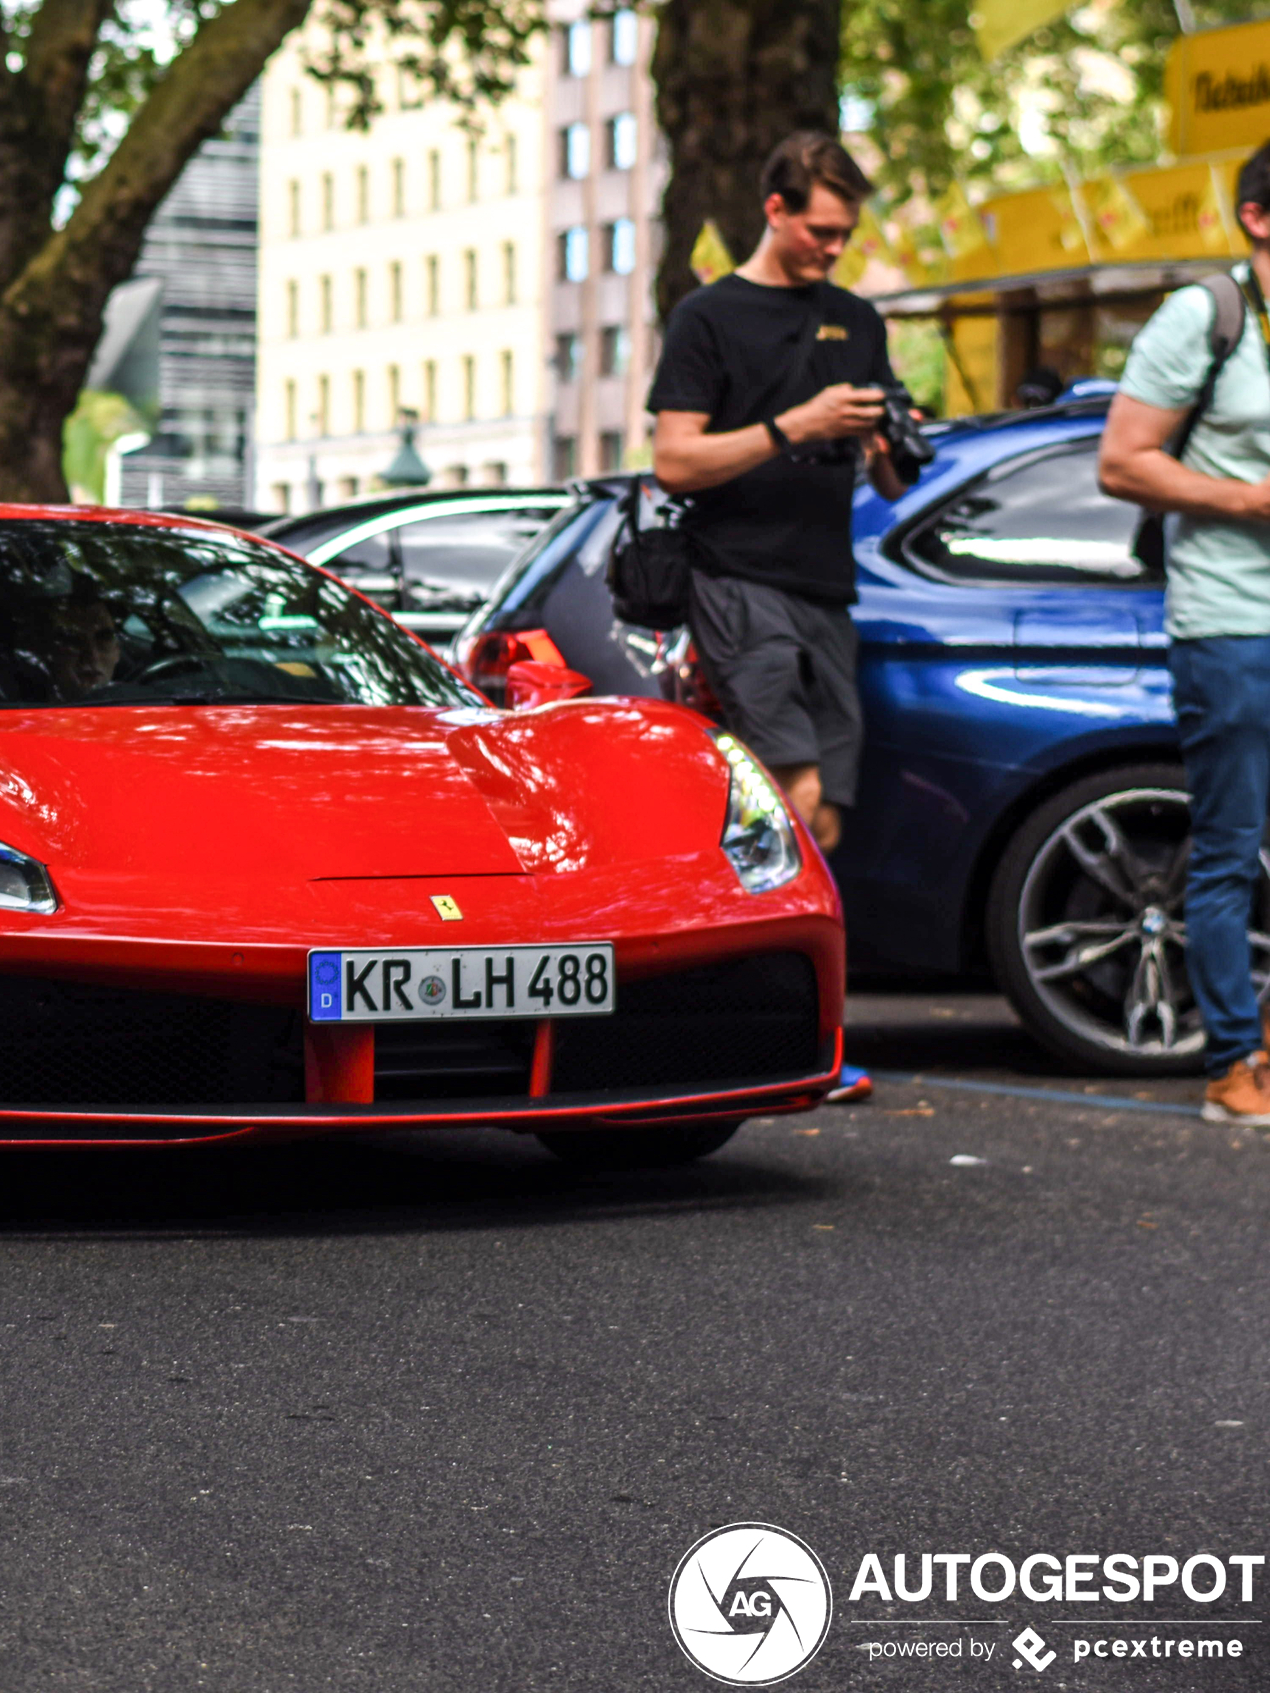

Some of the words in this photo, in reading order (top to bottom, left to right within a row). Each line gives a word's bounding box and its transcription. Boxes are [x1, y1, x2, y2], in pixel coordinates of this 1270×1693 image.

[321, 993, 332, 1008] D
[346, 959, 414, 1012] KR
[451, 956, 515, 1010] LH
[527, 953, 609, 1008] 488
